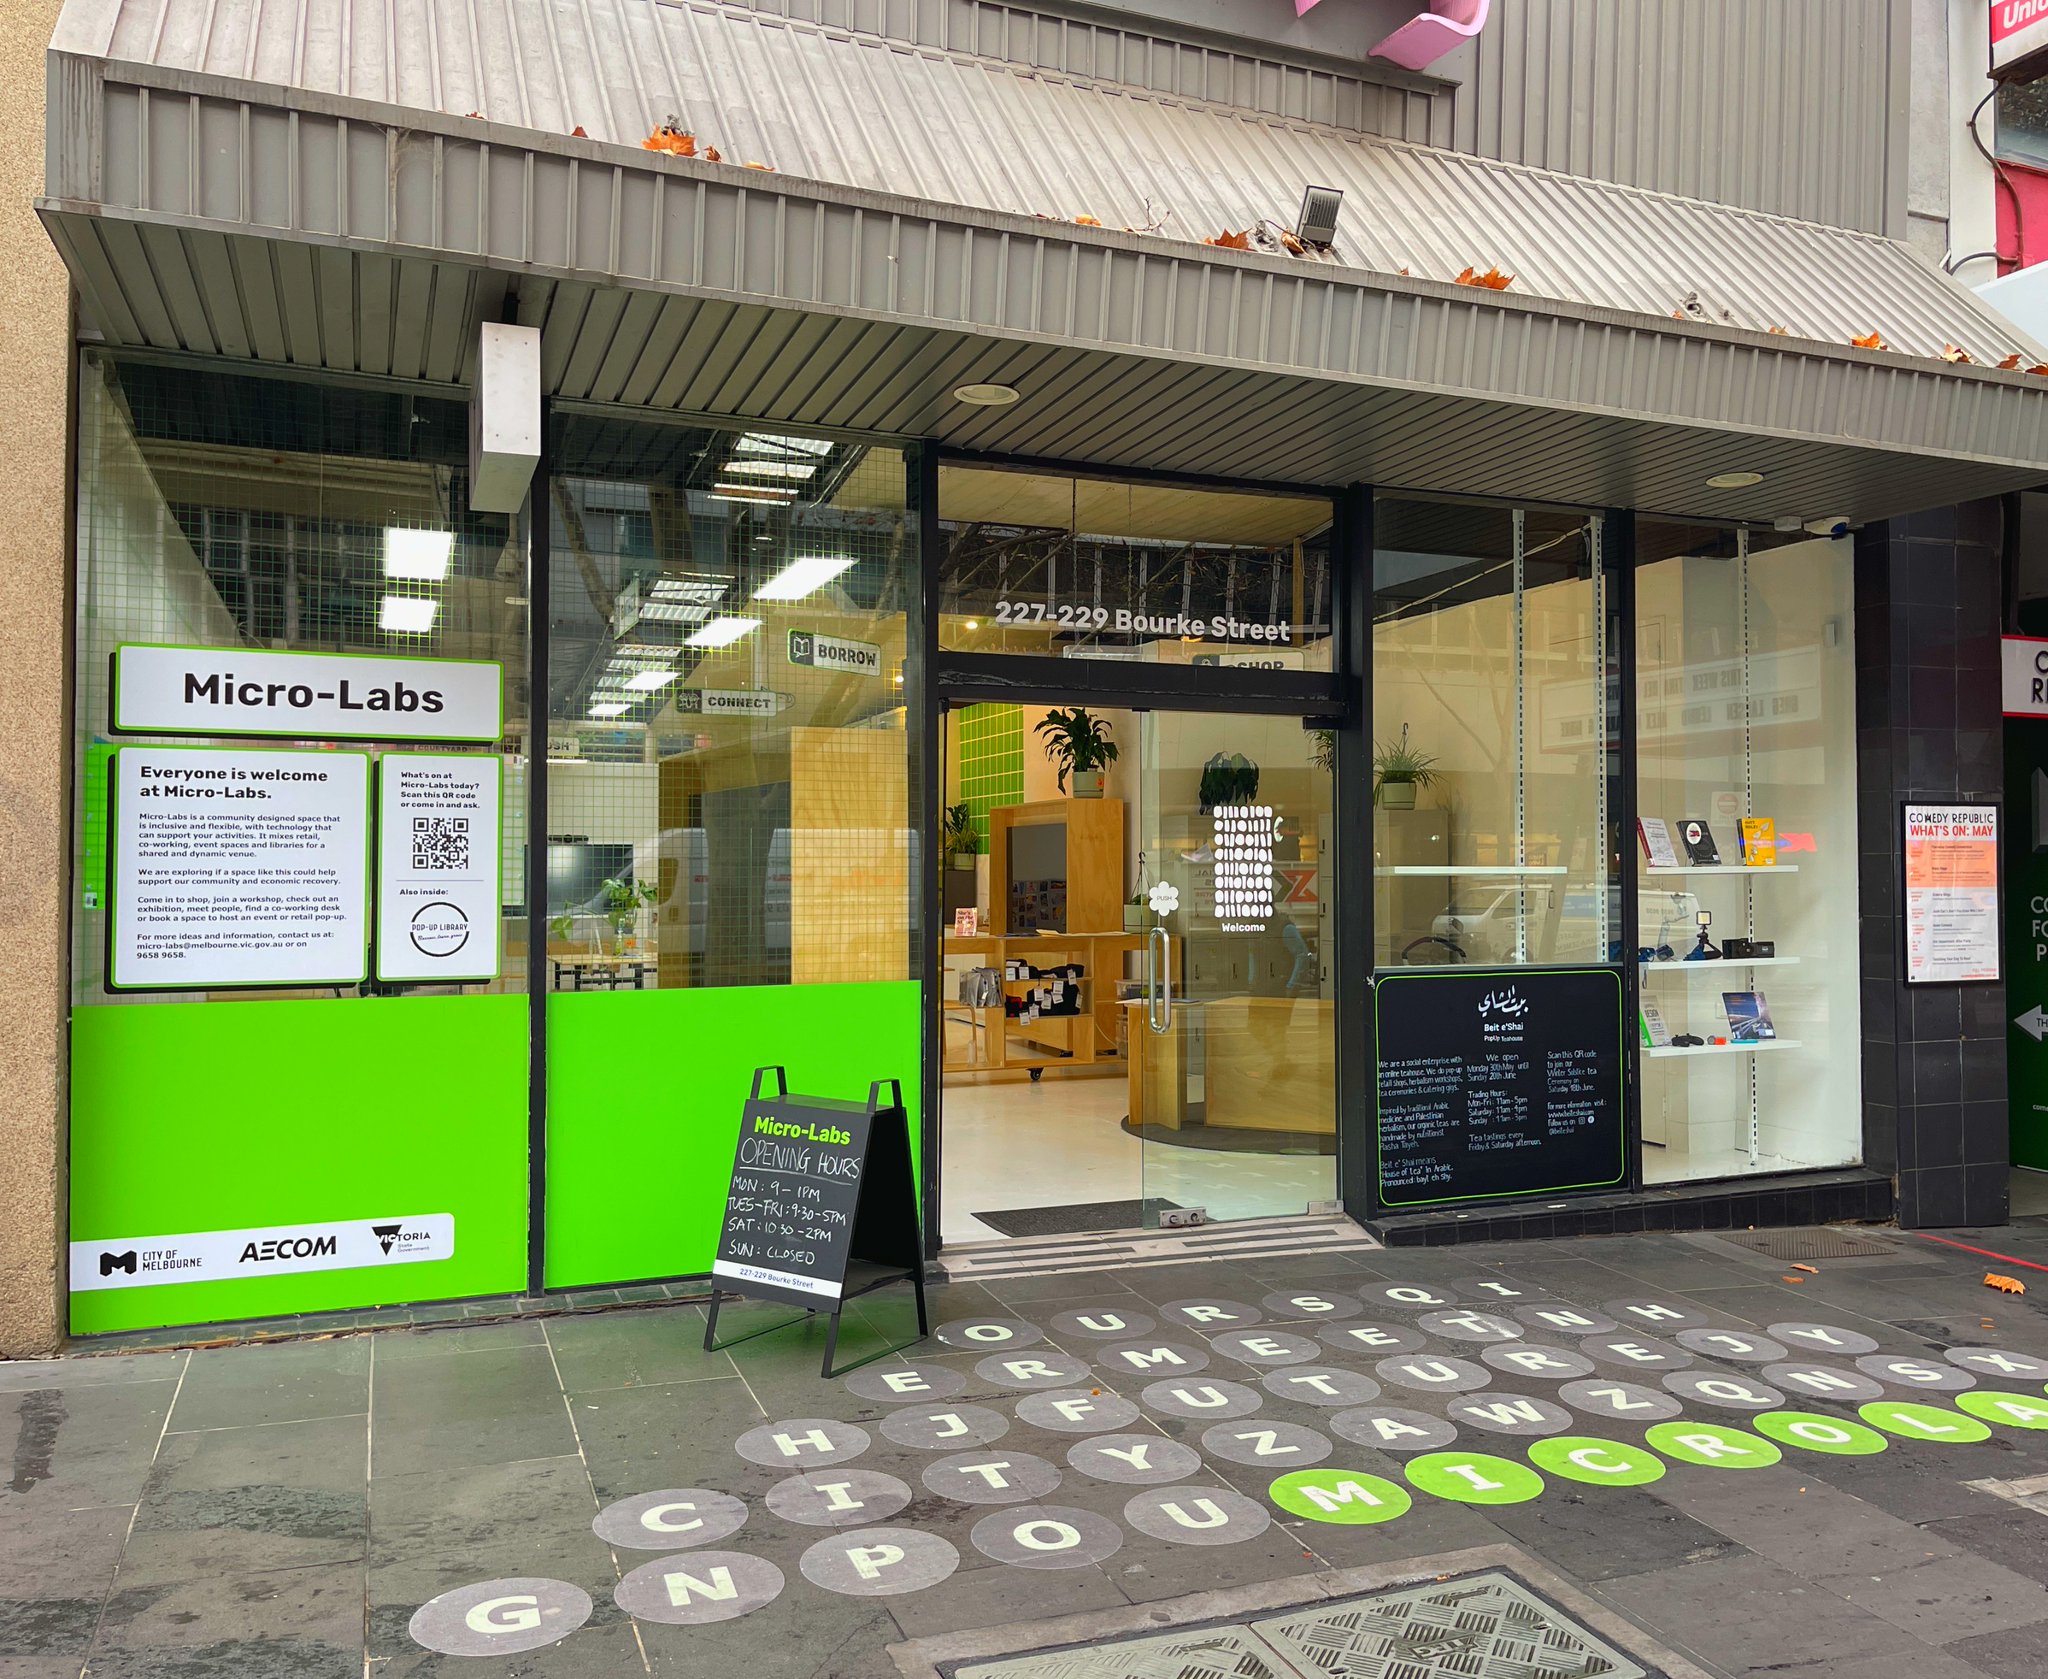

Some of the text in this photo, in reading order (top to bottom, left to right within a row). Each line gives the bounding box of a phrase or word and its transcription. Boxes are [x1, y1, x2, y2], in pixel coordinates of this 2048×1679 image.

[995, 601, 1290, 641] 227-229 Bourke Street
[818, 643, 876, 667] BORROW
[184, 672, 444, 713] Micro-Labs
[707, 695, 771, 709] CONNECT
[141, 766, 328, 782] Everyone is welcome
[401, 771, 429, 779] What's
[401, 781, 480, 791] Micro-Labs today?
[140, 784, 272, 799] at Micro-Labs.
[442, 791, 454, 799] QR
[190, 813, 197, 821] is
[207, 814, 255, 822] community
[257, 814, 295, 823] designed
[1909, 813, 1994, 824] COMEDY REPUBLIC
[1910, 825, 1994, 836] WHAT'S ON: MAY
[156, 832, 191, 840] support
[269, 832, 294, 840] mixes
[296, 833, 320, 841] retail,
[189, 850, 226, 859] dynamic
[138, 868, 153, 876] We
[171, 868, 213, 877] exploring
[293, 868, 316, 876] could
[318, 868, 336, 877] help
[411, 923, 468, 931] POP-UP LIBRARY
[1222, 923, 1266, 932] Welcome
[137, 933, 152, 941] For
[204, 932, 221, 940] and
[222, 932, 275, 940] information,
[136, 941, 283, 950] micro-labs@melbourne.vic.gov.au
[161, 951, 186, 959] 9658.
[1484, 1022, 1524, 1031] Beit e'Shai
[1502, 1054, 1519, 1062] open
[1468, 1090, 1489, 1098] Trading
[754, 1115, 851, 1145] Micro-Labs
[740, 1137, 861, 1178] OPENING HOURS
[238, 1236, 337, 1263] AECOM
[142, 1249, 178, 1262] CITY OF
[767, 1246, 815, 1265] CLOSED
[142, 1258, 203, 1271] MELBOURNE
[740, 1268, 814, 1289] 227-229 Bourke Street
